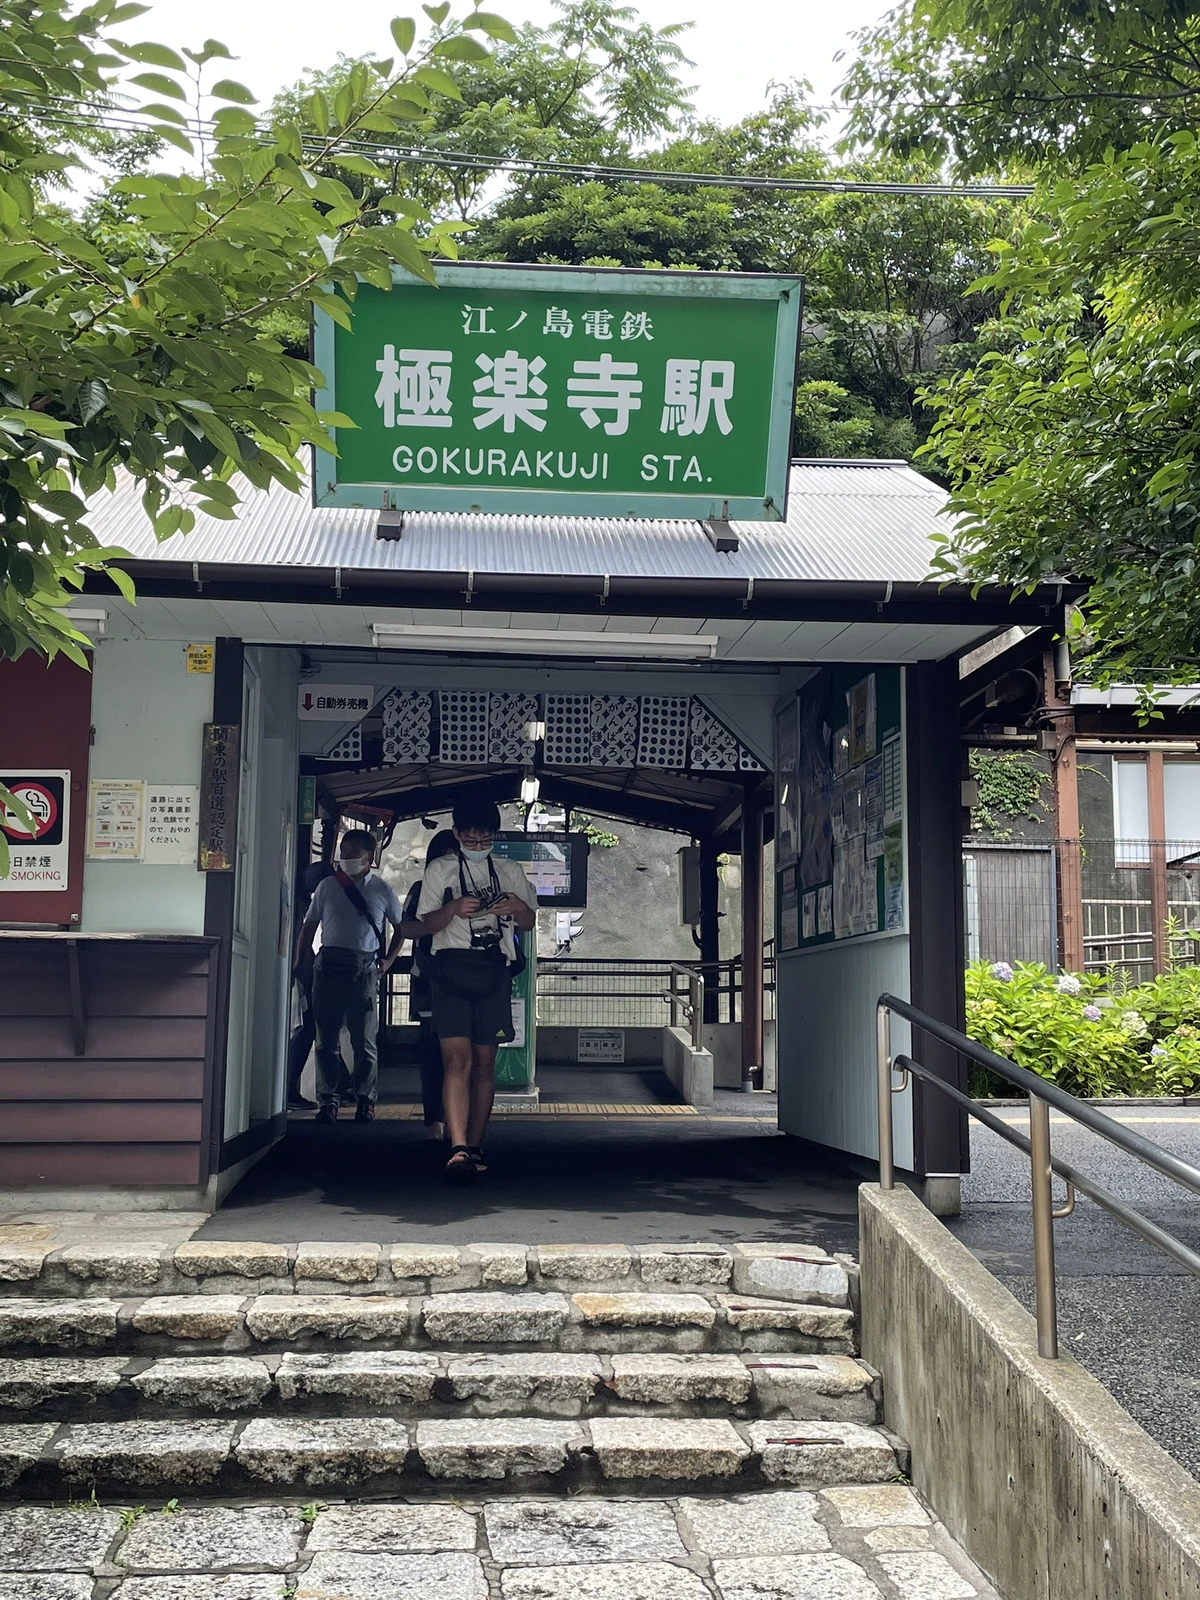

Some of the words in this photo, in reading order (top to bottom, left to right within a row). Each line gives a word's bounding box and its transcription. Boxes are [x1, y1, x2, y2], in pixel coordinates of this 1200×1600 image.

[461, 304, 655, 341] 江ノ島電鉄
[374, 344, 735, 436] 極楽寺駅
[392, 446, 608, 480] GOKURAKUJI
[640, 454, 712, 483] STA.
[316, 696, 369, 710] 自動券売機
[417, 698, 430, 754] みんなで
[624, 703, 637, 758] みんなで
[708, 719, 720, 761] んばろ
[724, 735, 737, 762] なで
[209, 727, 228, 851] 関東の駅百選認定駅
[9, 856, 51, 868] 日禁煙
[11, 871, 61, 881] SMOKING
